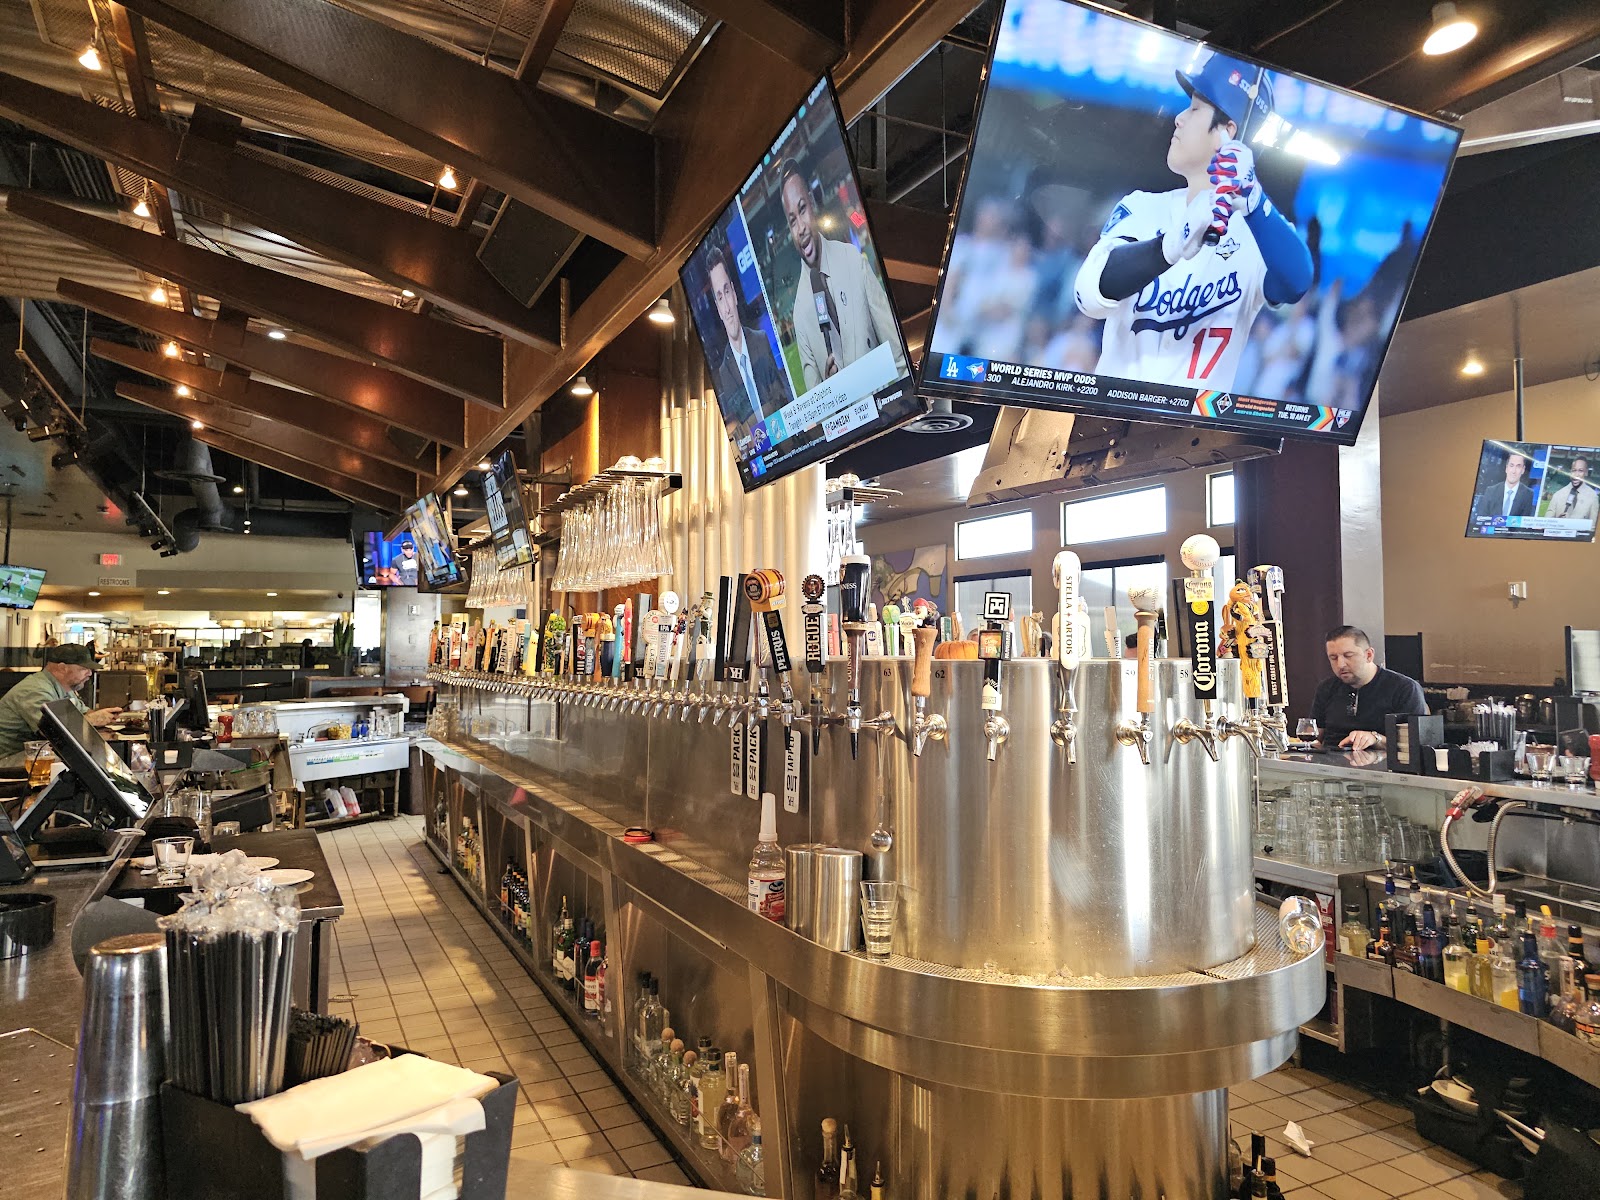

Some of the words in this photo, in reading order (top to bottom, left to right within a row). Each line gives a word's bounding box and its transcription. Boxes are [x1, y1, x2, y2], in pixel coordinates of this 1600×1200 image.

[1133, 271, 1242, 340] Dodgers
[1187, 328, 1233, 379] 17
[990, 362, 1022, 376] WORLD
[1023, 367, 1053, 380] SERIES
[1053, 371, 1073, 382] MVP
[1073, 374, 1097, 385] ODDS
[1011, 377, 1054, 390] ALEJANDRO
[1055, 383, 1075, 392] KIRK:
[1076, 385, 1099, 395] +2200
[1107, 389, 1139, 401] ADDISON
[1139, 394, 1168, 405] BARGER:
[1169, 399, 1190, 407] +2700
[100, 578, 130, 586] RESTROOMS
[1065, 575, 1073, 609] STELLA
[770, 629, 788, 673] PETRUS
[805, 616, 820, 661] ROGUE
[1065, 620, 1073, 655] ARTOIS
[1193, 620, 1217, 691] Corona
[883, 668, 892, 677] 63
[935, 670, 945, 679] 62
[1180, 669, 1189, 678] 58
[1270, 681, 1278, 696] WEST
[732, 729, 741, 761] PACK
[749, 729, 757, 763] PACK
[749, 765, 757, 782] SIX
[787, 774, 797, 793] OUT
